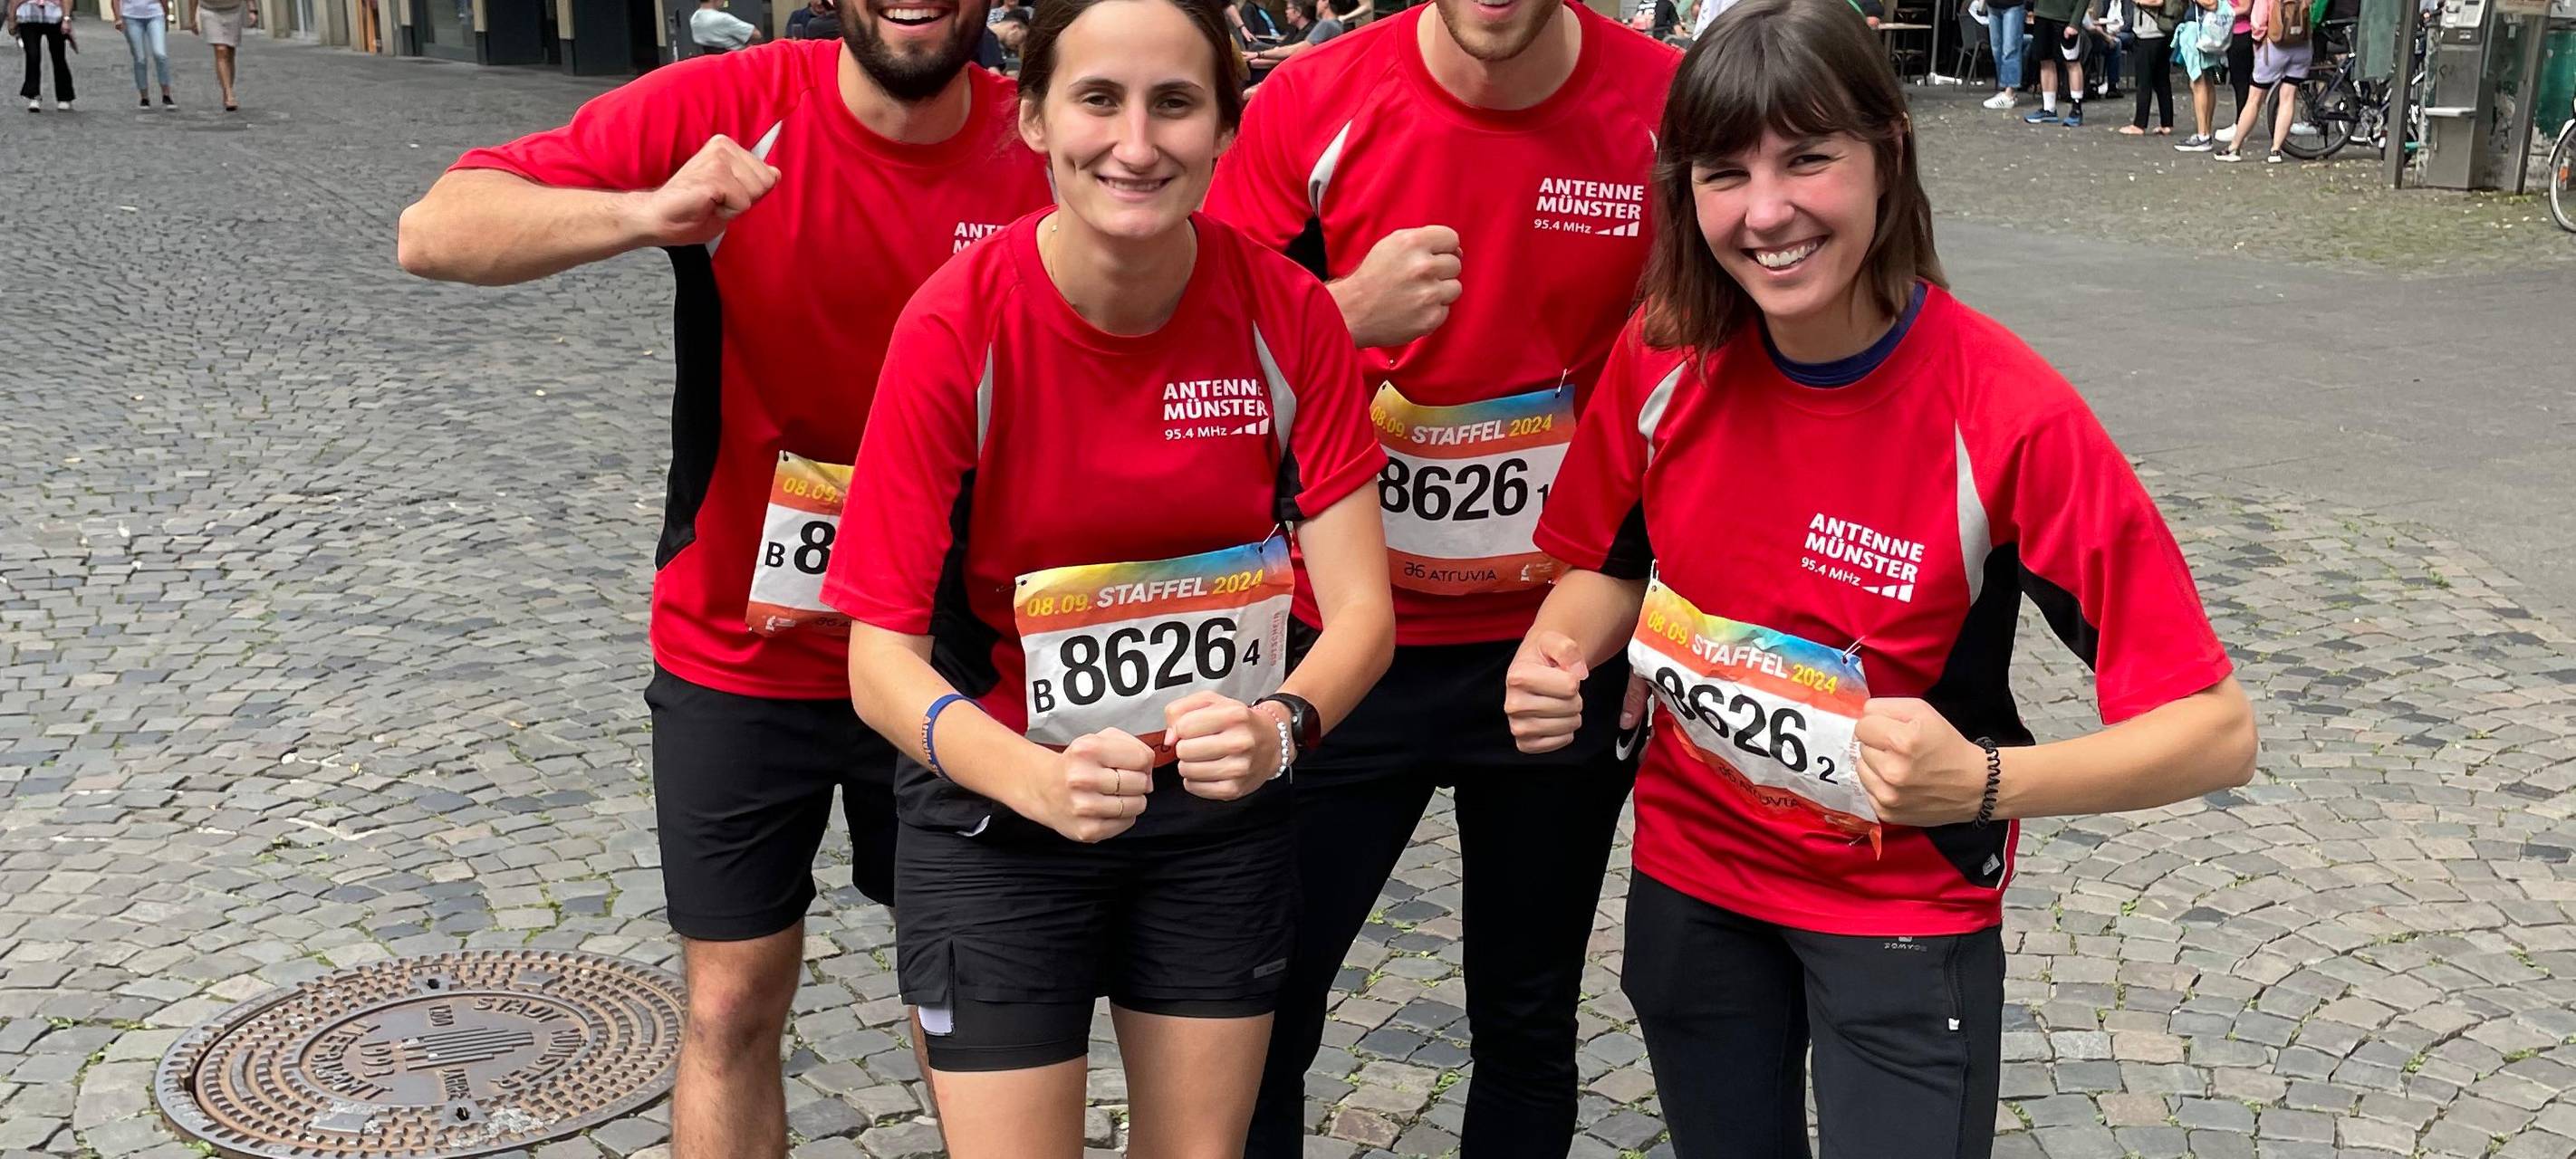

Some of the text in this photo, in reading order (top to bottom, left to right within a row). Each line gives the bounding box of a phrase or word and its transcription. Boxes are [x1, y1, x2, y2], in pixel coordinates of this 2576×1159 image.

[1539, 177, 1644, 201] ANTENNE
[1536, 195, 1641, 219] MÜNSTER
[1533, 219, 1591, 234] 95.4 MHz
[1164, 398, 1269, 420] MÜNSTER
[1165, 426, 1227, 440] 95.4 MHz
[1370, 406, 1552, 445] 08.09. STAFFEL 2024
[783, 477, 838, 503] 08.09.
[1378, 455, 1550, 522] 8626 1
[1809, 512, 1925, 563] ANTENNE
[765, 541, 785, 568] B
[1804, 532, 1918, 584] MÜNSTER
[1801, 557, 1861, 586] 95.4 MHz
[1026, 569, 1264, 617] 08.09. STAFFEL 2024
[1033, 679, 1055, 714] B
[1060, 617, 1238, 705] 8626
[1243, 638, 1261, 666] 4
[1647, 609, 1839, 694] 08.09. STAFFEL 2024
[1816, 756, 1839, 785] 2
[473, 997, 570, 1023] STADT
